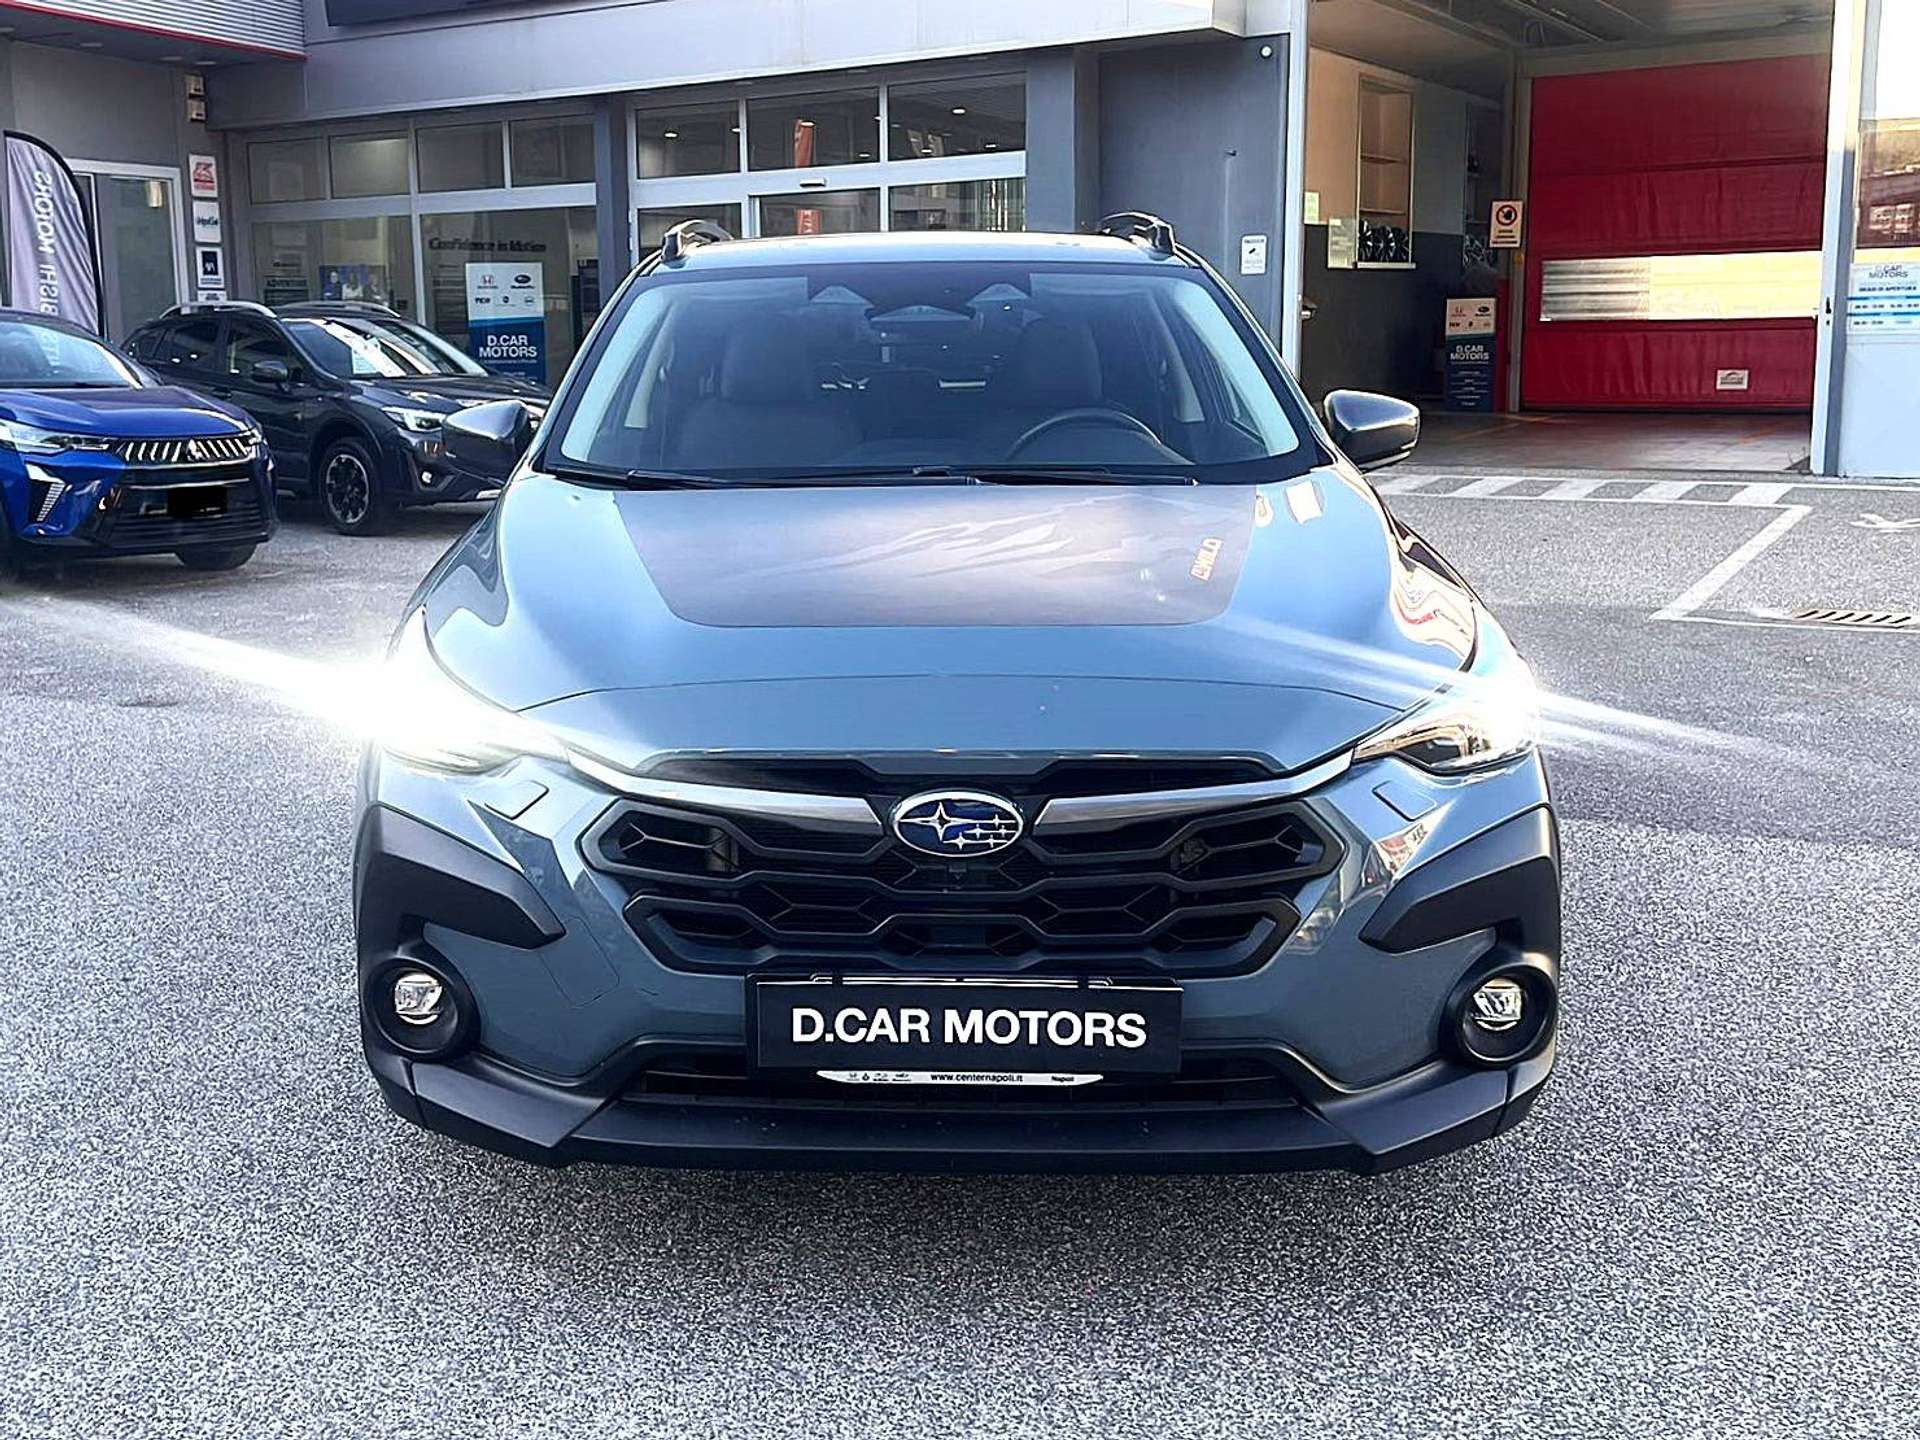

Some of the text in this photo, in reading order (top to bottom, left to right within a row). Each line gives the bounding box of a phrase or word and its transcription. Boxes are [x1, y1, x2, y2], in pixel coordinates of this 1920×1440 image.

[487, 335, 528, 346] D.CAR
[479, 346, 537, 358] MOTORS
[1450, 352, 1489, 360] MOTORS
[792, 1007, 1147, 1048] D.CAR MOTORS
[930, 1074, 1074, 1083] www.centernapoli.it Napoli
